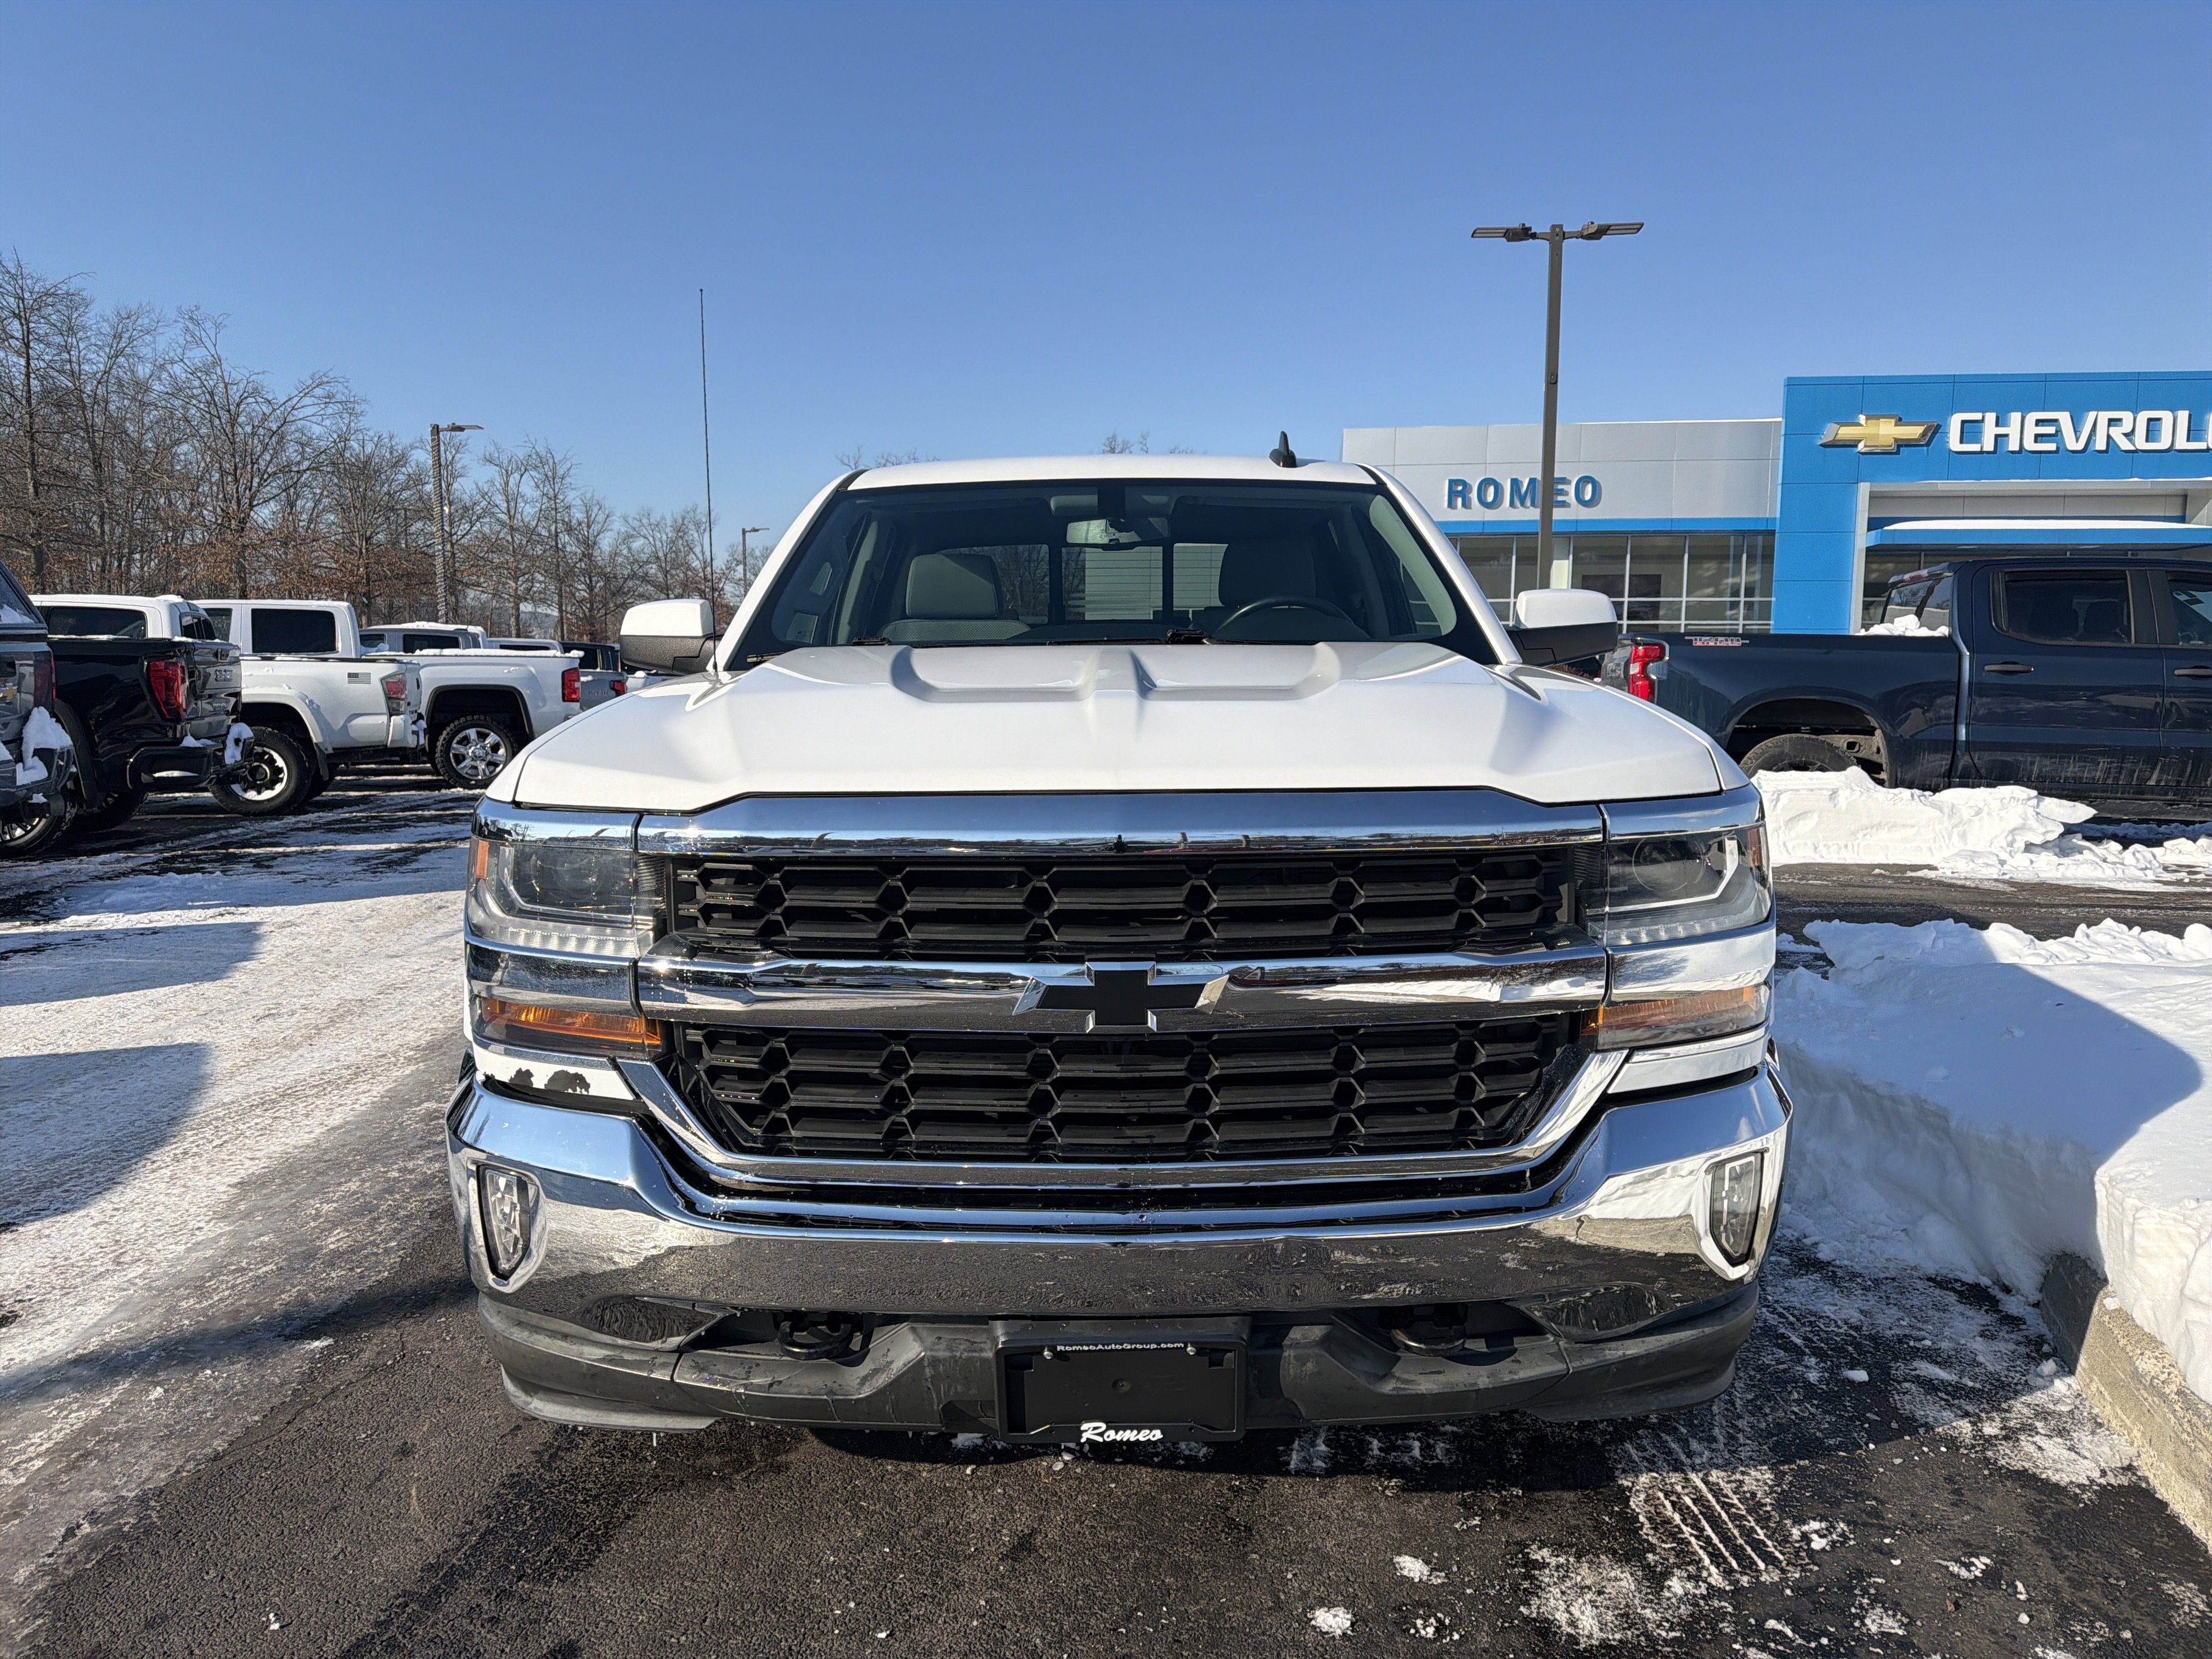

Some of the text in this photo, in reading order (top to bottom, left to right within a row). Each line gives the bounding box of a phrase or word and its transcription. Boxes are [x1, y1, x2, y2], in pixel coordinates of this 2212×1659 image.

[1949, 410, 2212, 452] CHEVROL
[1446, 475, 1599, 509] ROMEO
[1057, 1343, 1184, 1352] RomeoAutoGroup.com
[1080, 1422, 1164, 1443] Romeo
